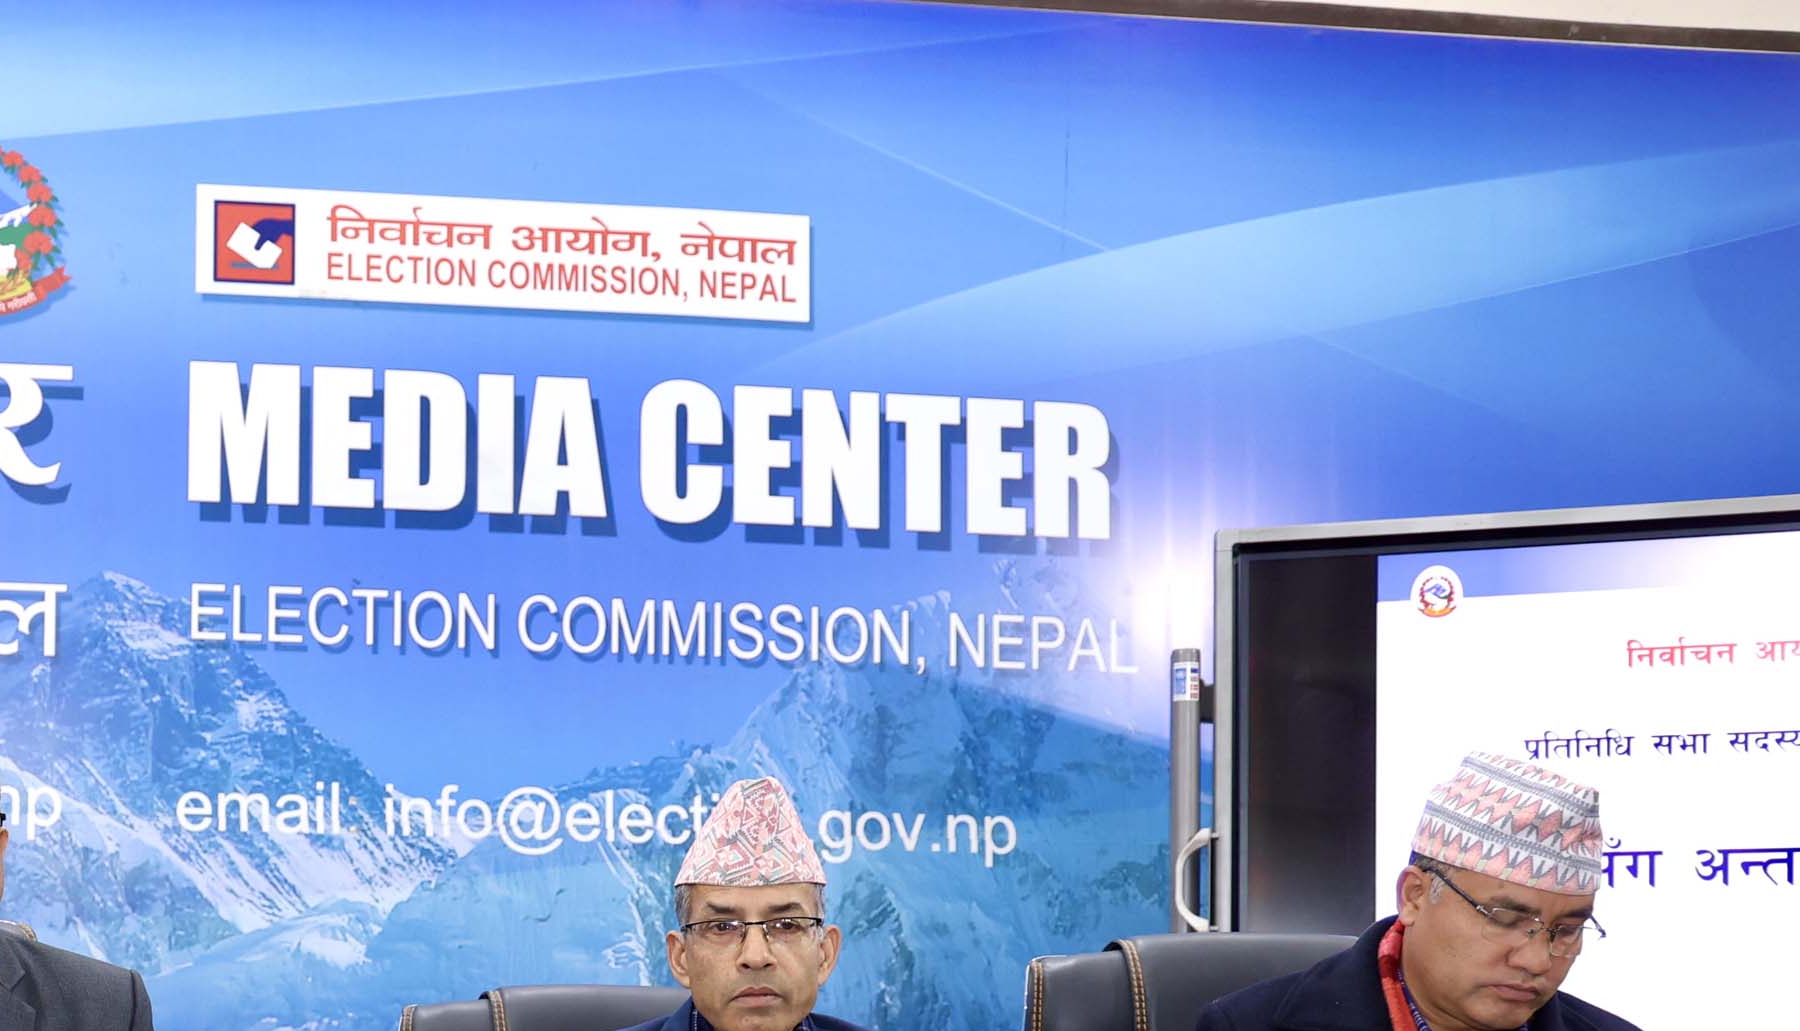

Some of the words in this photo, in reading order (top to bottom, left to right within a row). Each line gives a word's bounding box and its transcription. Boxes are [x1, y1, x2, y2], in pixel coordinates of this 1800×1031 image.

[327, 204, 492, 251] निर्वाचन
[511, 216, 661, 260] आयोग,
[680, 222, 797, 266] नेपाल
[327, 252, 477, 288] ELECTION
[488, 259, 688, 304] COMMISSION,
[699, 271, 797, 303] NEPAL
[188, 361, 607, 518] MEDIA
[641, 379, 1111, 540] CENTER
[191, 583, 497, 652] ELECTION
[517, 596, 926, 675] COMMISSION,
[947, 610, 1140, 675] NEPAL
[1626, 637, 1737, 668] निर्वाचन
[1524, 728, 1635, 760] प्रतिनिधि
[1651, 733, 1711, 755] सभा
